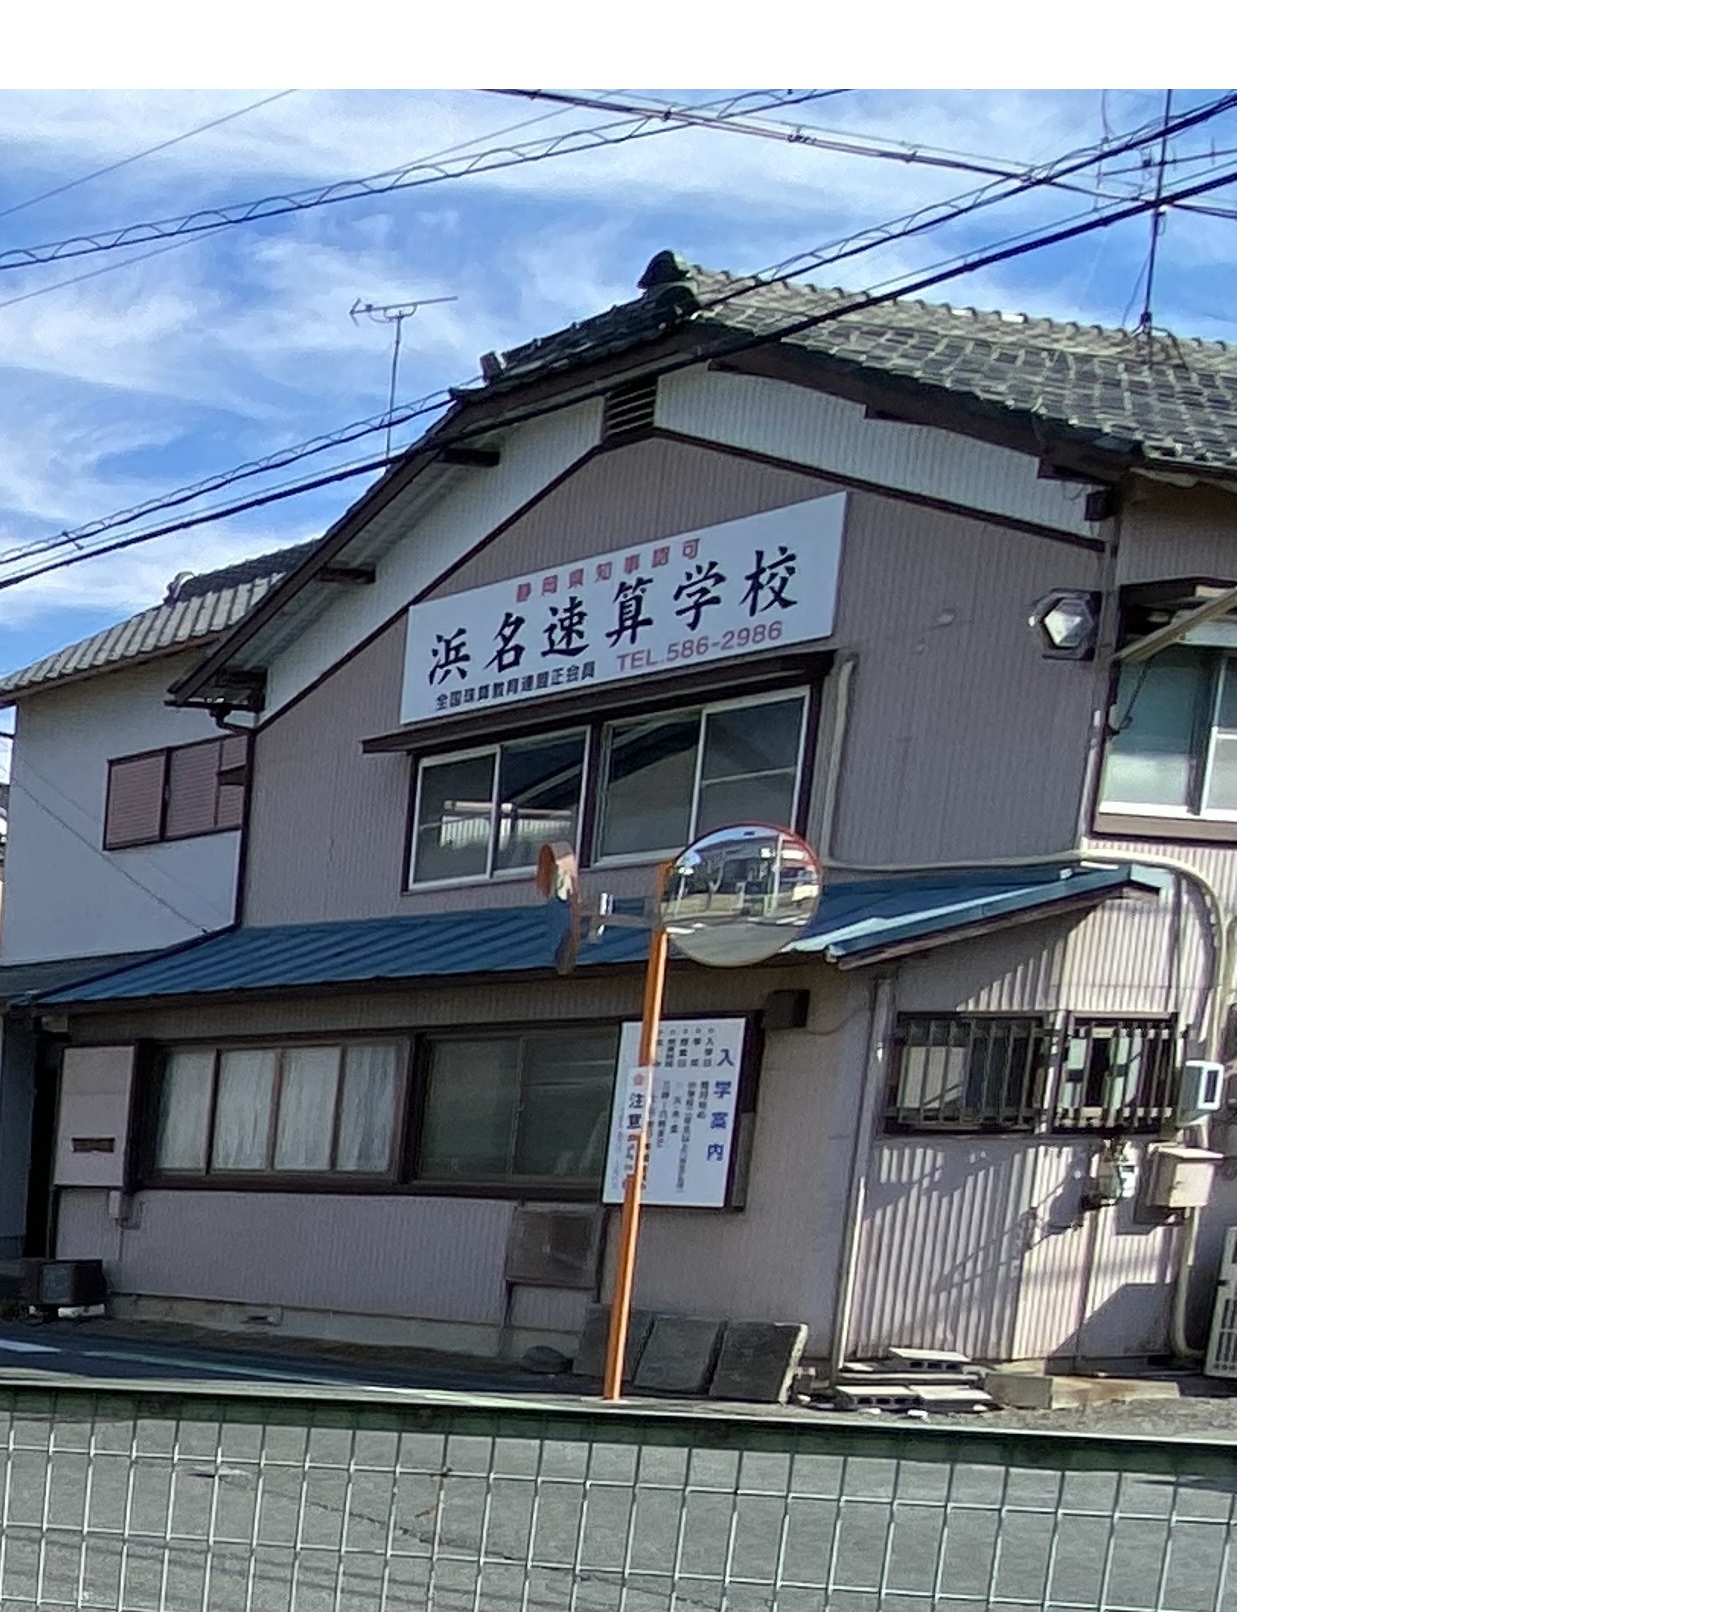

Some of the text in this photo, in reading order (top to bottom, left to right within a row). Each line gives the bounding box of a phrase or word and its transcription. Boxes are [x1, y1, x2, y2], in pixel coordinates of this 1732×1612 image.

[428, 546, 799, 686] 浜名速算学校
[707, 1048, 735, 1162] 入学案内
